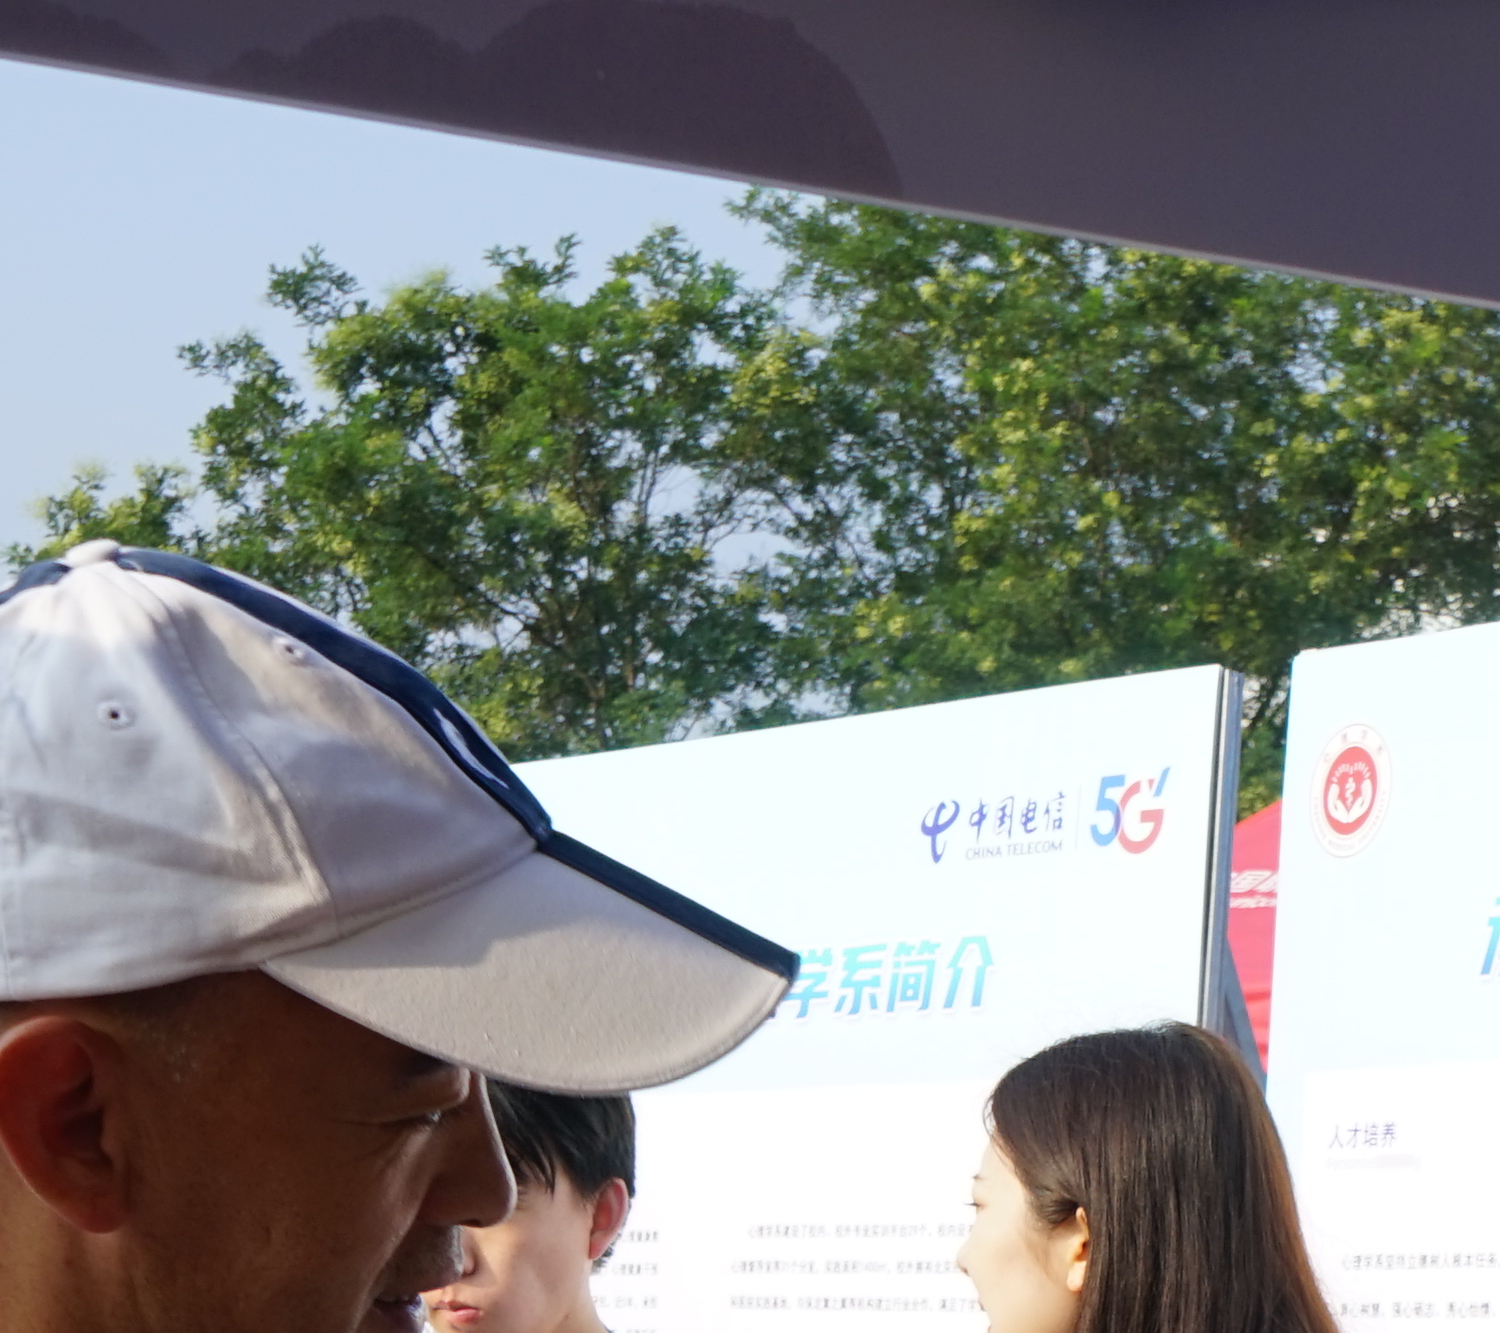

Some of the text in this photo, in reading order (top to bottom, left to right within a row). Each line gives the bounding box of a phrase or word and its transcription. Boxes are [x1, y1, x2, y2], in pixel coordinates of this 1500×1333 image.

[968, 767, 1173, 854] 中国电信 5G
[965, 839, 1064, 861] CHINA TELECOM
[1327, 1121, 1397, 1150] 人才培养
